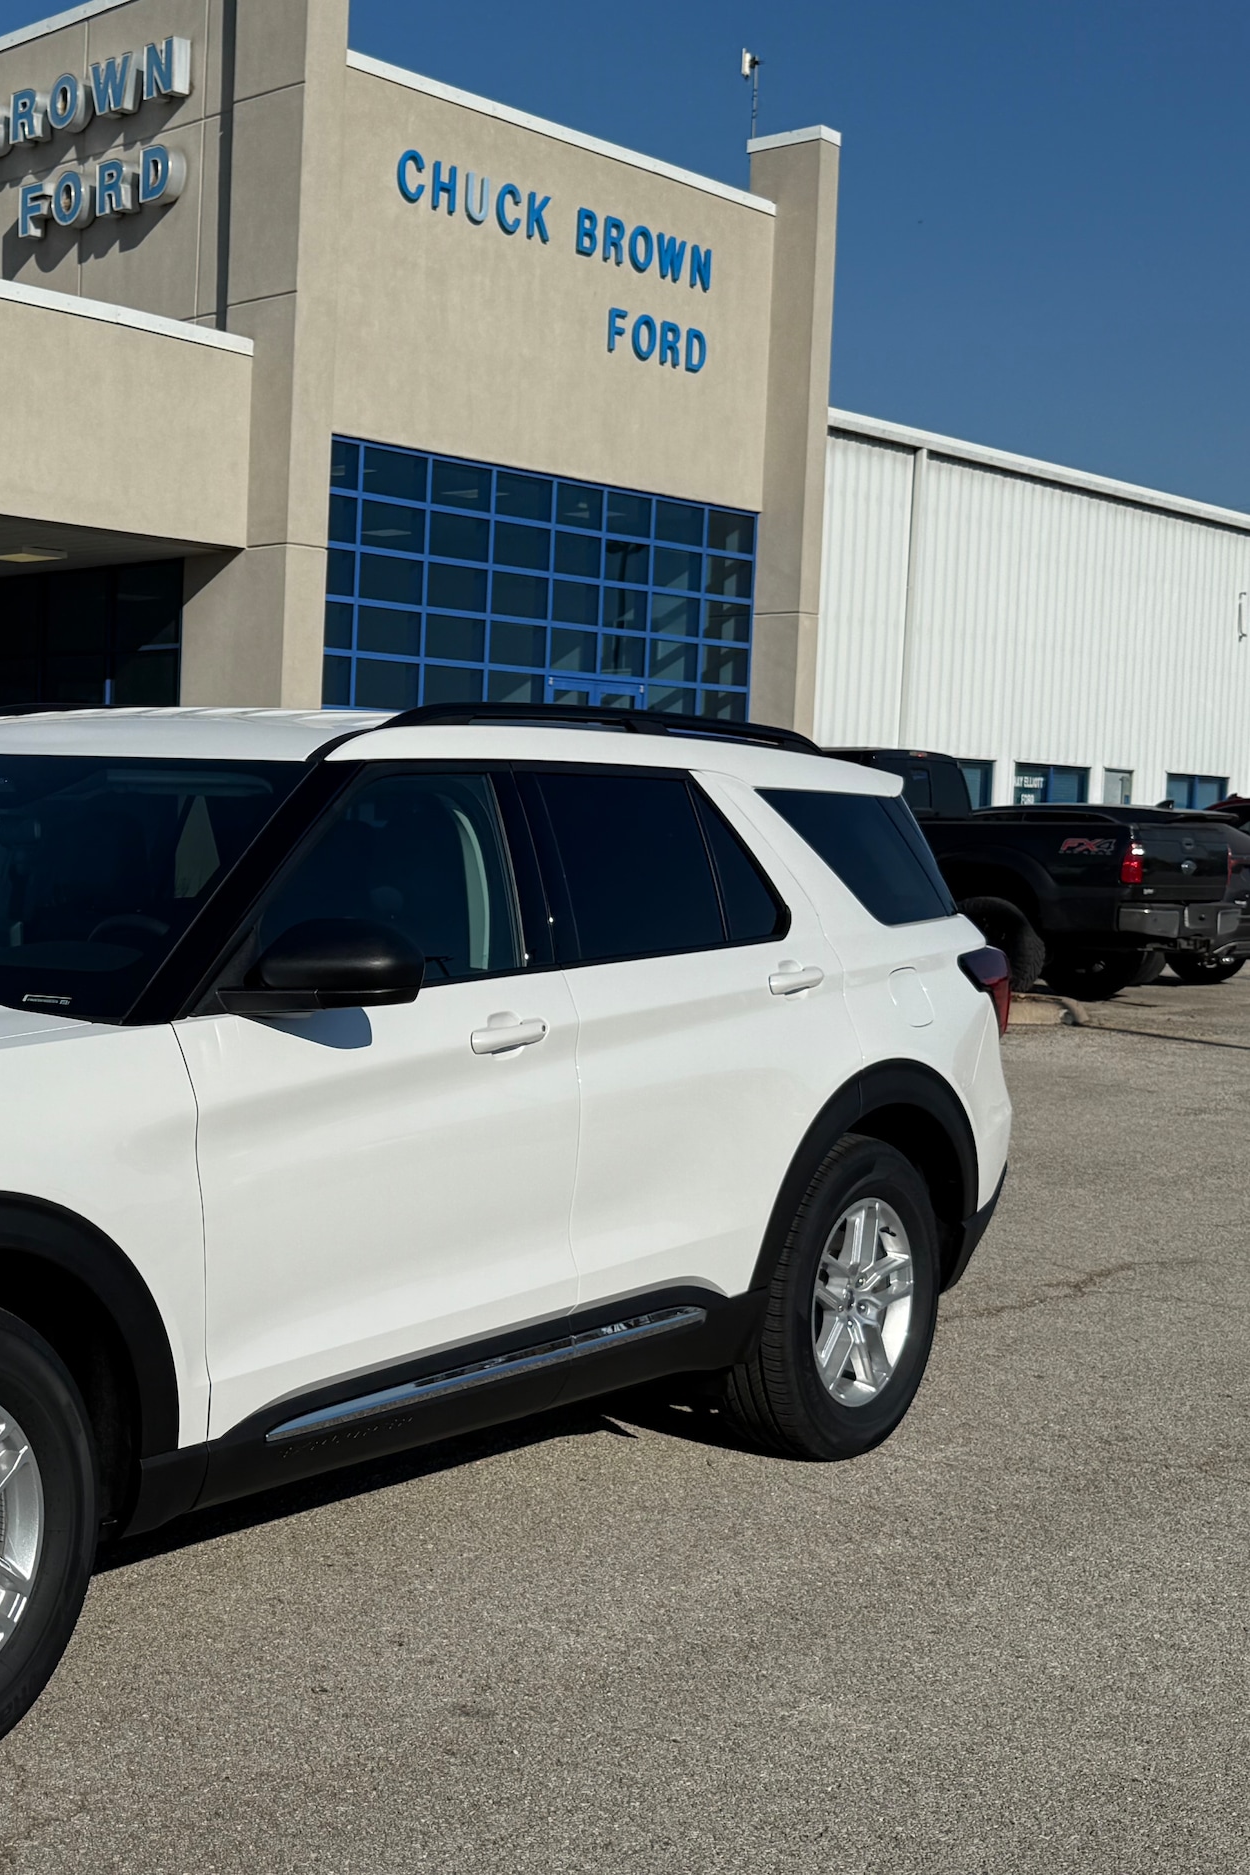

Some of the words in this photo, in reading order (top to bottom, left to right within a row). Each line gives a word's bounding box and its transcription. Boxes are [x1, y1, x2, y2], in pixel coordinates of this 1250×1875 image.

[18, 143, 186, 239] FORD
[396, 149, 551, 244] CHUCK
[575, 206, 712, 293] BROWN
[607, 306, 707, 373] FORD
[1060, 837, 1116, 852] FX4
